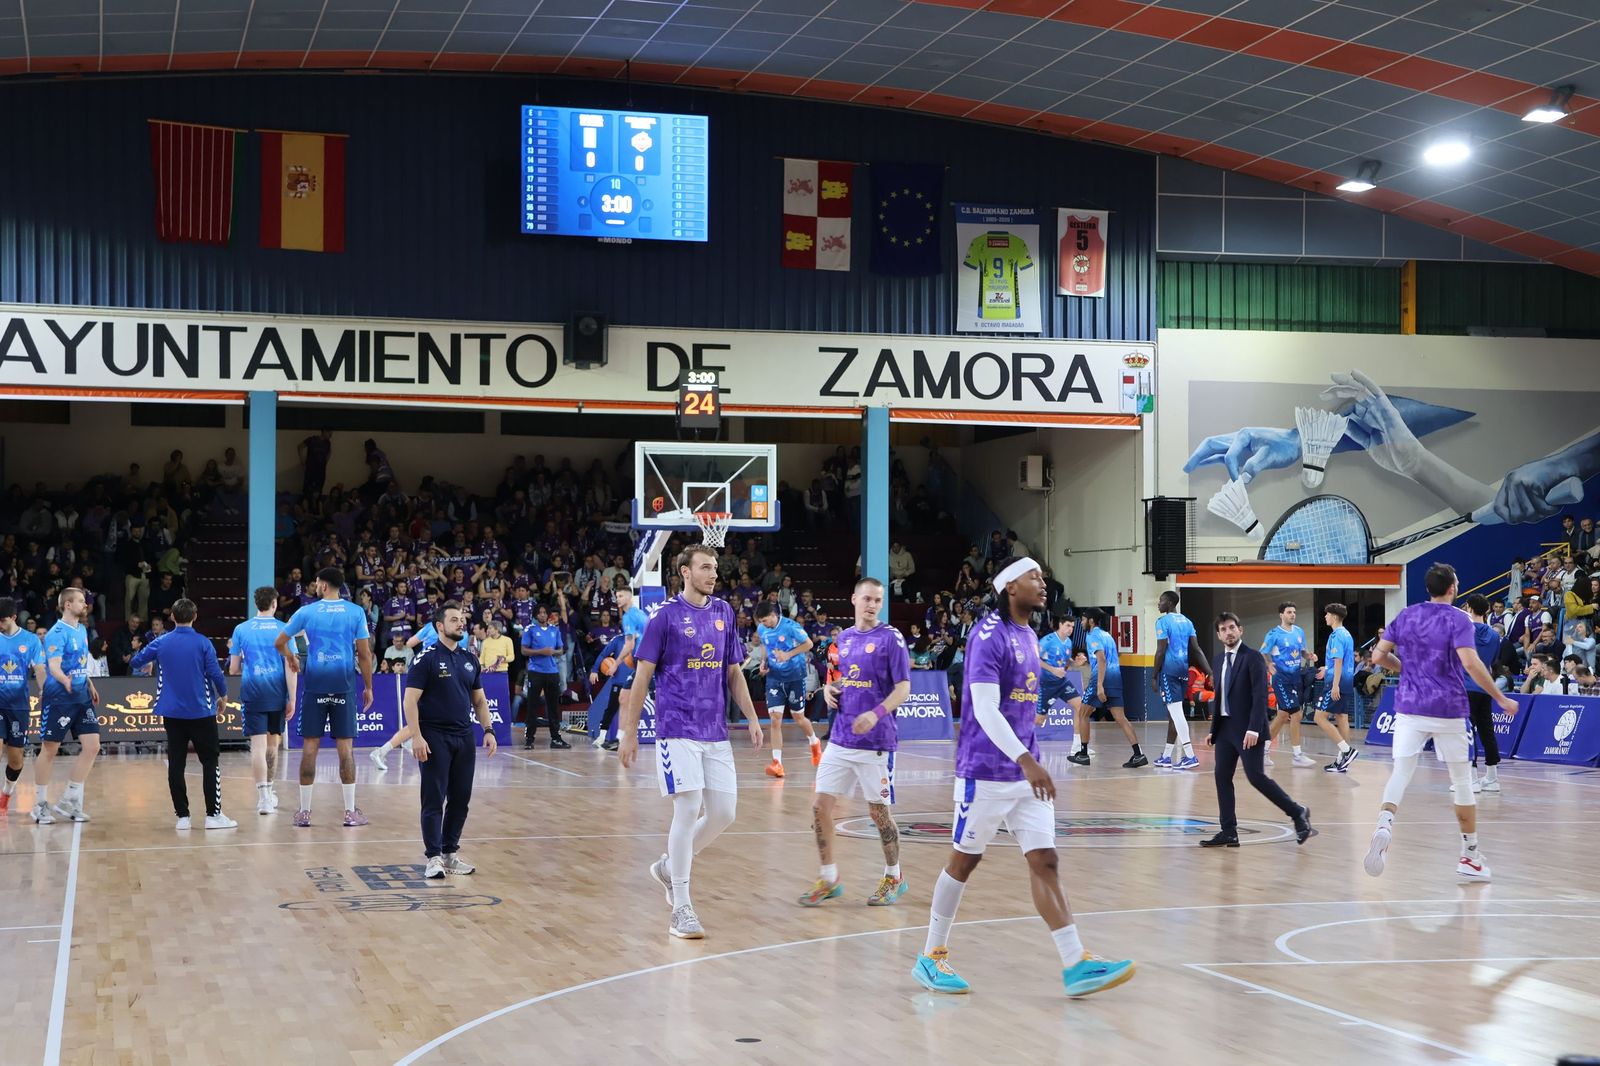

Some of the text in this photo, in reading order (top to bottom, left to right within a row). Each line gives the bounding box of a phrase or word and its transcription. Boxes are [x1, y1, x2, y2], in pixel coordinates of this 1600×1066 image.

[602, 194, 632, 214] 3:00
[1076, 230, 1088, 250] 5
[993, 258, 1004, 278] 9
[0, 317, 558, 388] AYUNTAMIENTO
[818, 346, 1103, 403] ZAMORA
[688, 372, 716, 384] 3:00
[684, 393, 714, 414] 24
[368, 712, 383, 720] de
[896, 706, 946, 718] AMORA
[1060, 706, 1072, 716] de
[356, 721, 384, 731] León
[1049, 716, 1074, 726] León
